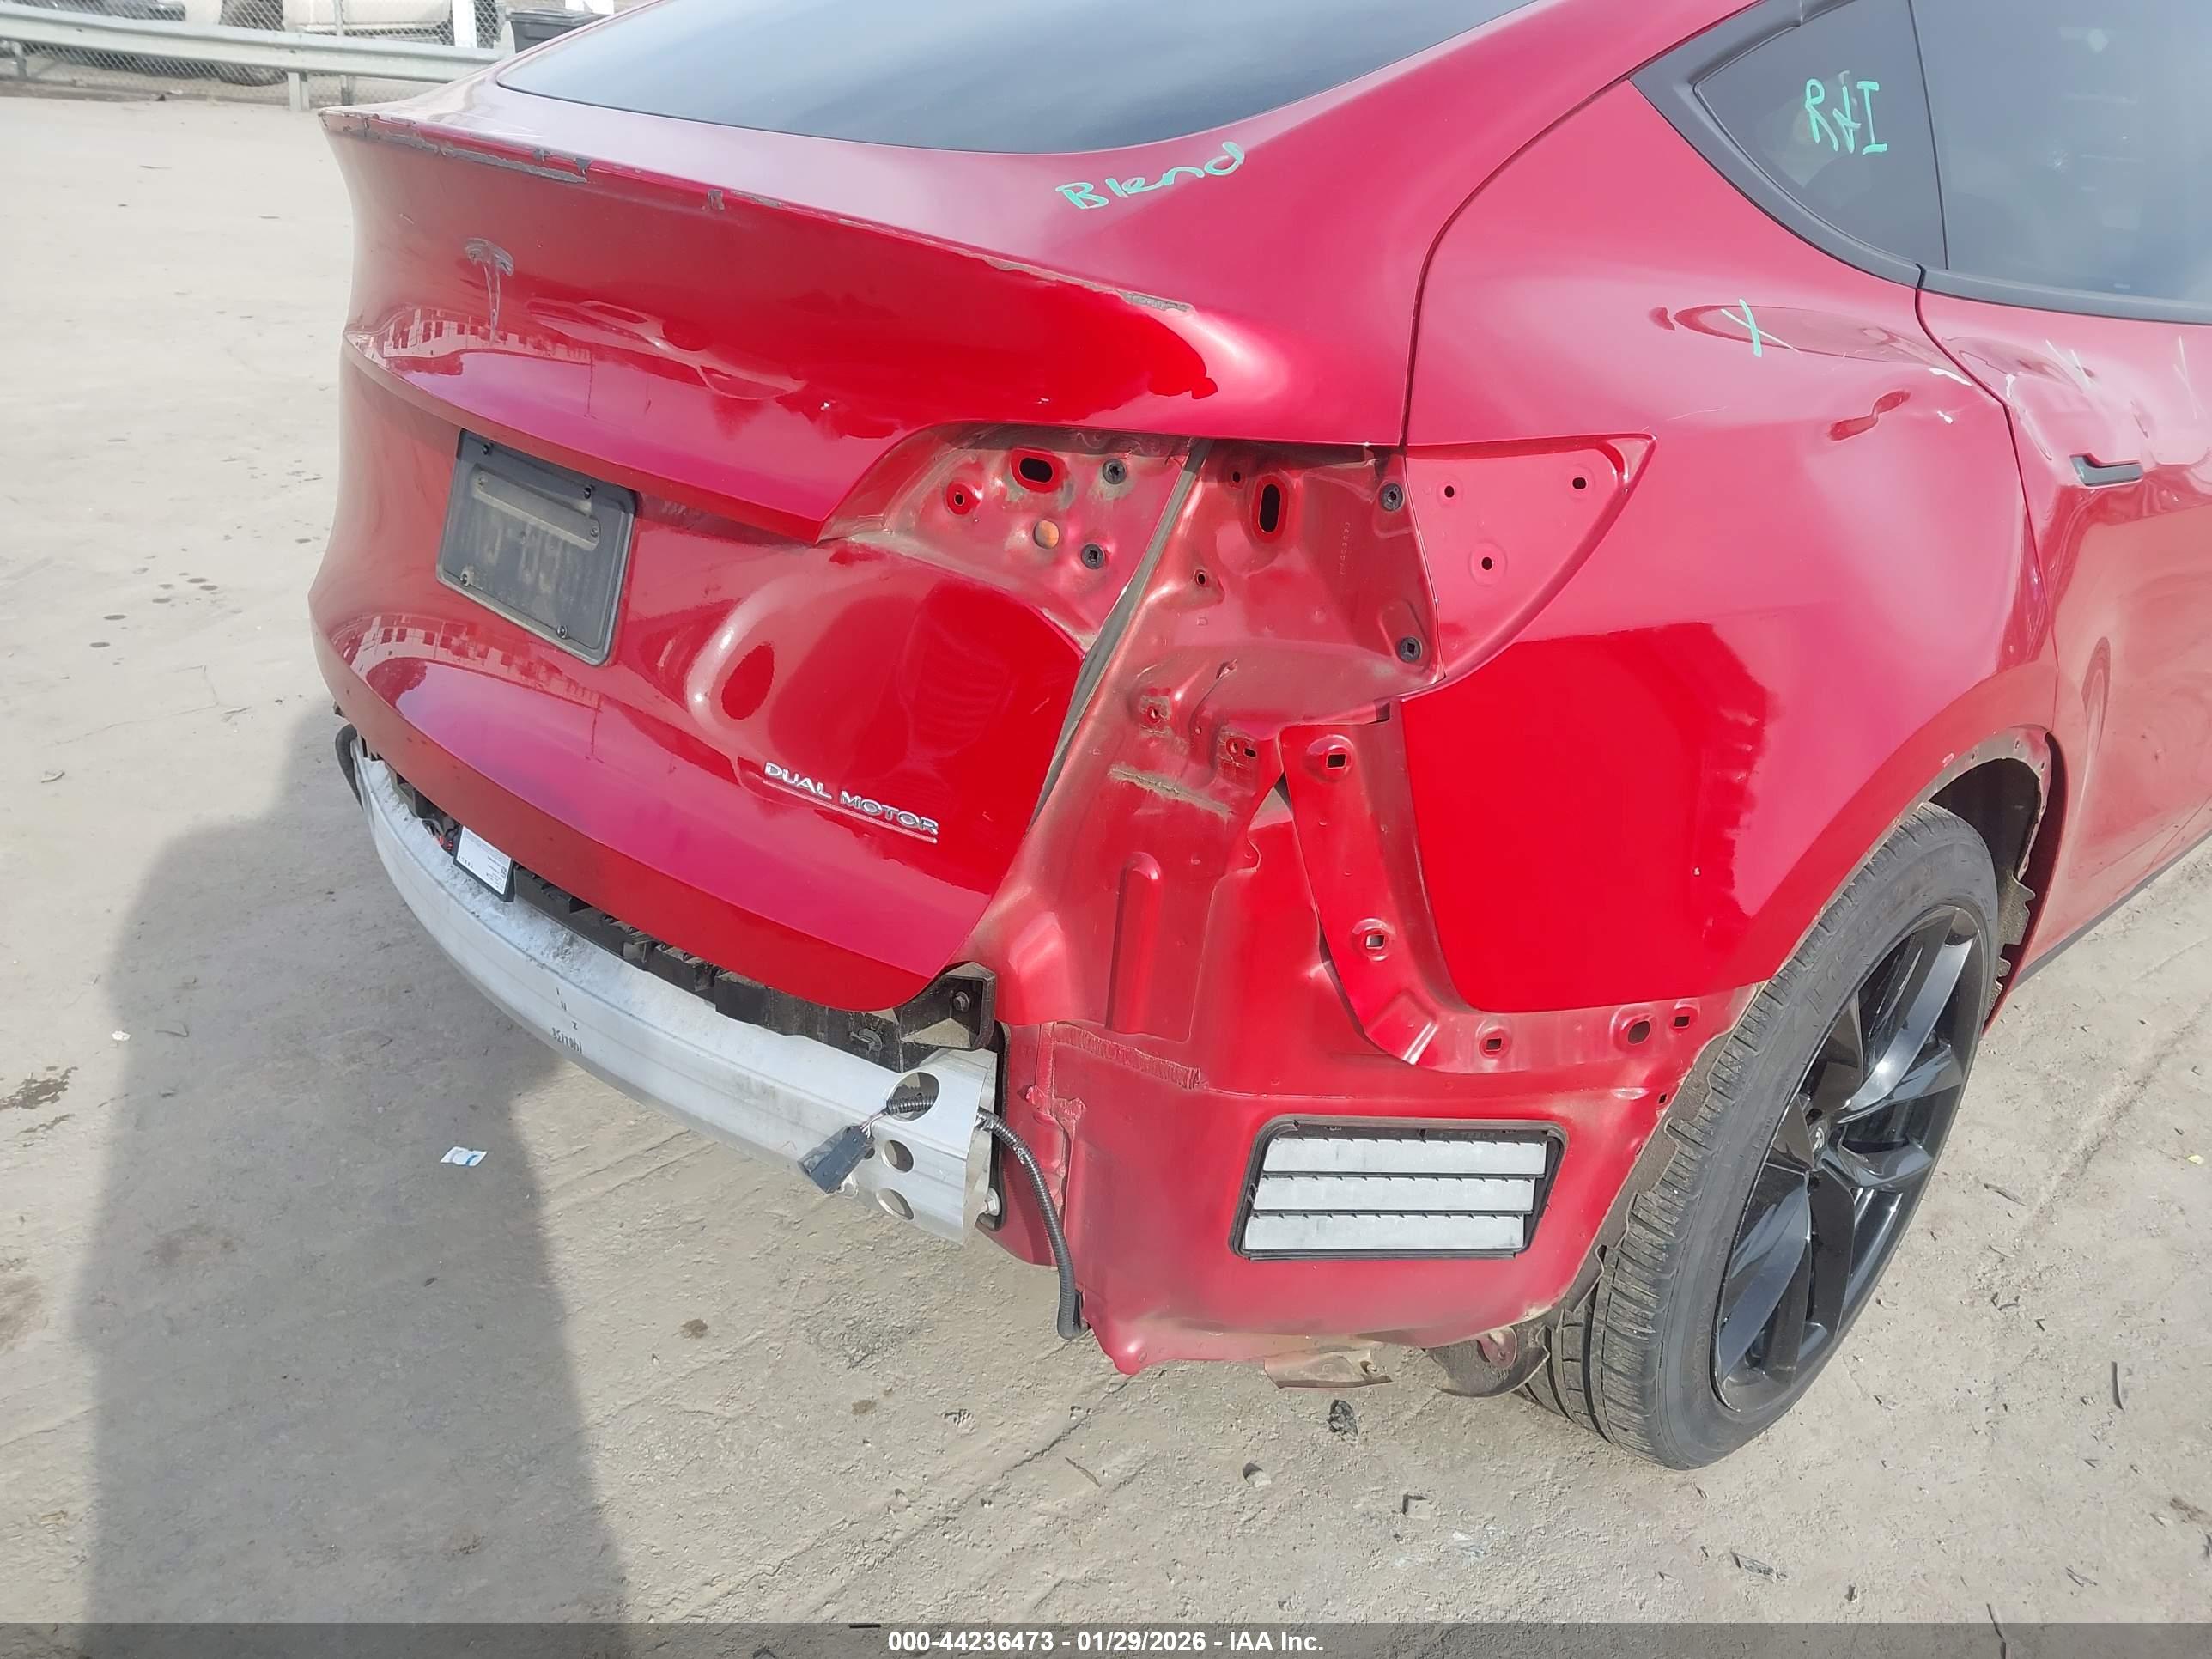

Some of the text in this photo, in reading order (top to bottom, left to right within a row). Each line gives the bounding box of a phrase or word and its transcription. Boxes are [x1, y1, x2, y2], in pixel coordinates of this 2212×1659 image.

[1055, 141, 1245, 209] Blend
[764, 761, 939, 836] DUAL MOTOR
